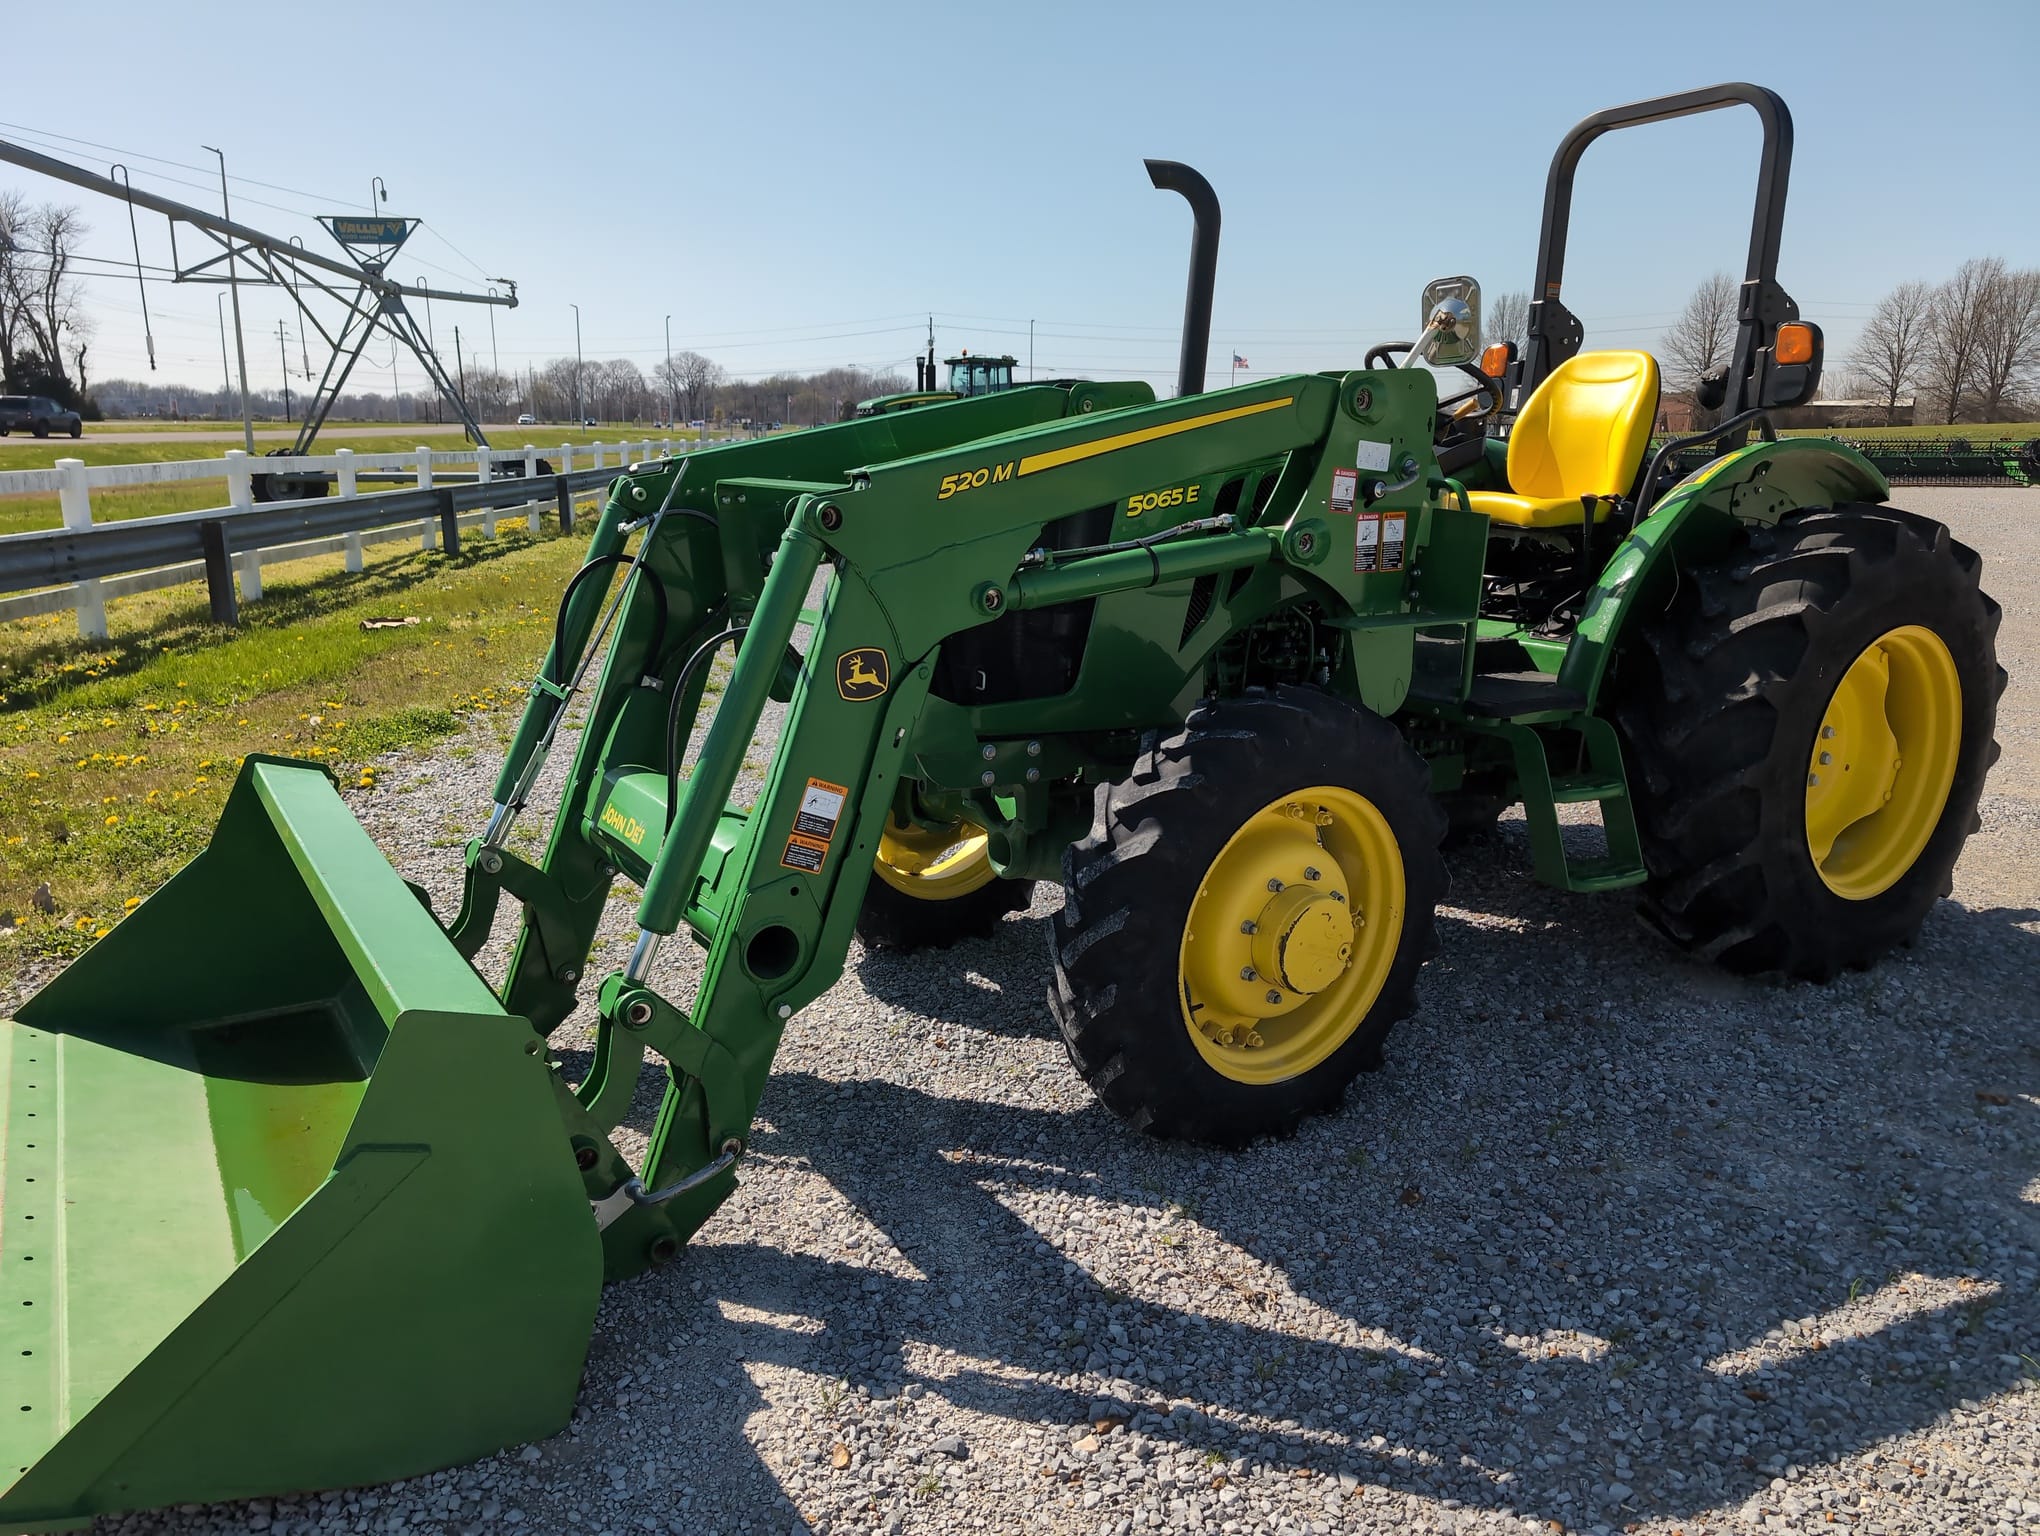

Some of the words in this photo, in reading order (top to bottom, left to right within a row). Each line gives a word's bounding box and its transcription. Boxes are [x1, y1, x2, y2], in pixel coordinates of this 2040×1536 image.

[337, 222, 385, 236] VALLEY
[937, 467, 990, 500] 520
[992, 461, 1014, 484] M
[1126, 487, 1184, 517] 5065
[1186, 484, 1201, 503] E
[818, 783, 843, 794] WARNING
[602, 802, 627, 833] JOHN
[799, 840, 825, 850] WARNING
